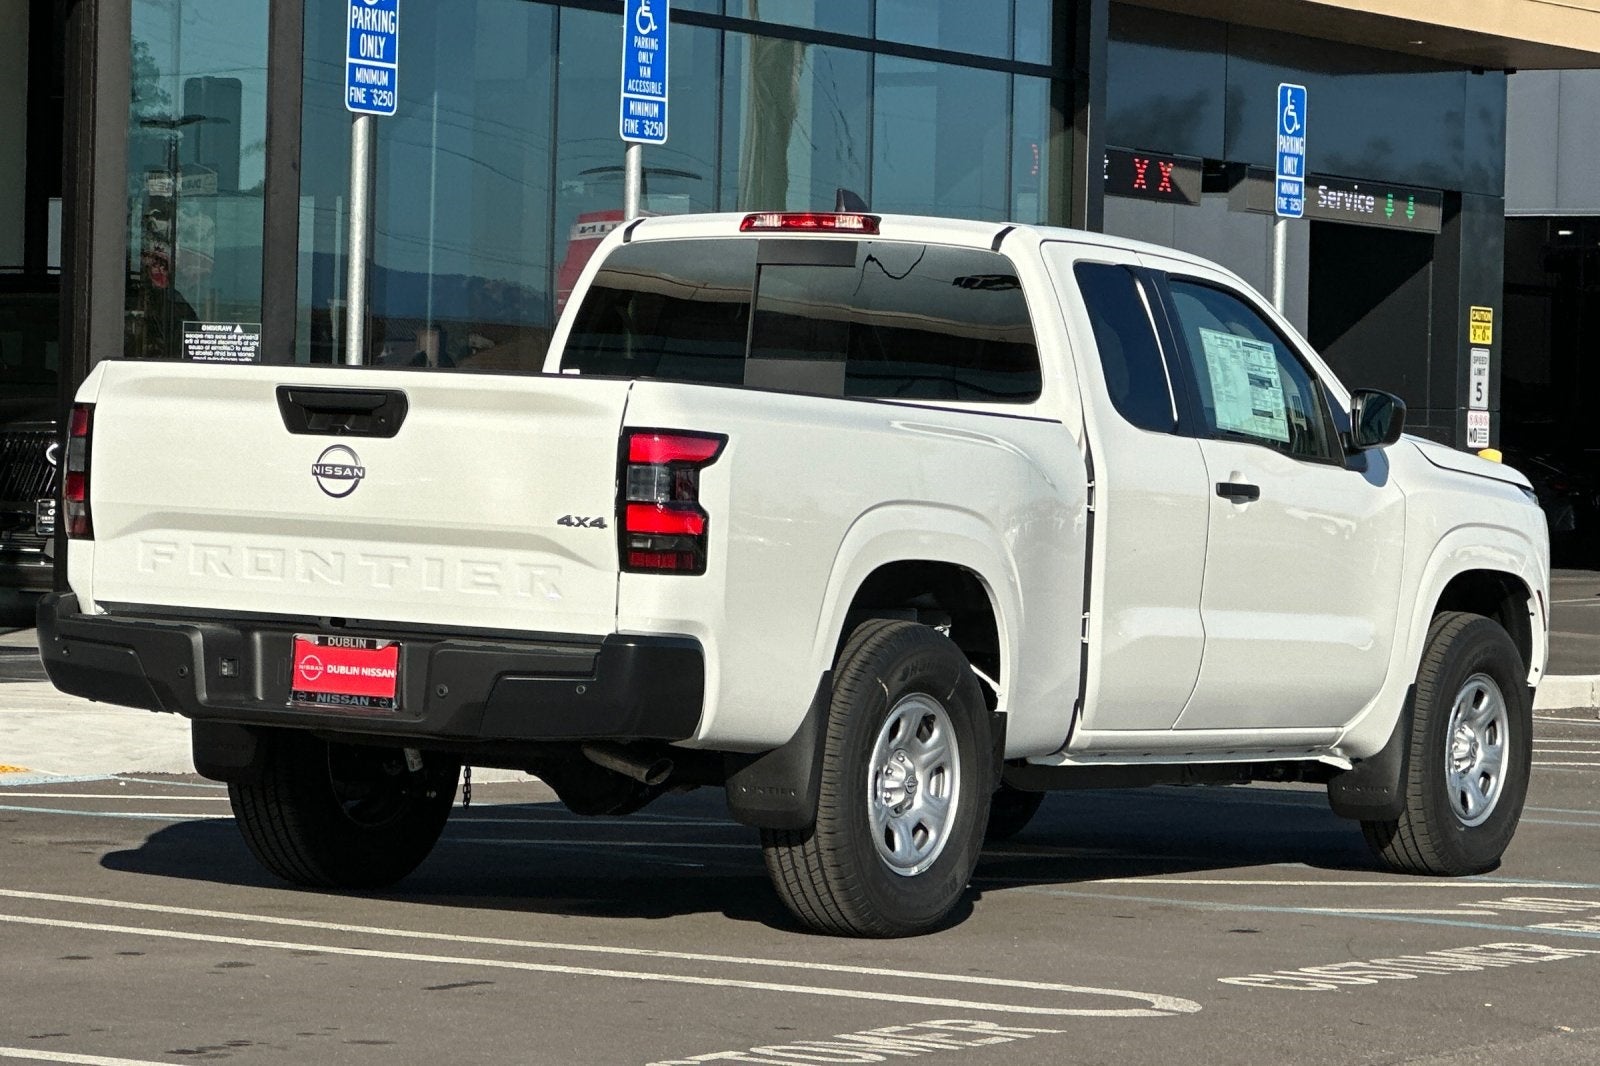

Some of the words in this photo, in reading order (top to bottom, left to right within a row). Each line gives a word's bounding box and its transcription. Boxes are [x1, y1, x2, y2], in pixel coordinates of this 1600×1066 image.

[351, 5, 396, 35] PARKING
[359, 33, 386, 59] ONLY
[633, 35, 659, 51] PARKING
[637, 50, 654, 65] ONLY
[355, 67, 389, 87] MINIMUM
[639, 65, 652, 79] VAN
[627, 78, 663, 95] ACCESSIBLE
[349, 86, 367, 104] FINE
[370, 88, 393, 107] $250
[629, 100, 659, 118] MINIMUM
[624, 118, 640, 135] FINE
[642, 119, 664, 137] $250
[1279, 134, 1304, 156] PARKING
[1283, 155, 1299, 175] ONLY
[1318, 184, 1375, 213] Service
[1473, 355, 1488, 366] SPEED
[1473, 367, 1486, 377] LIMIT
[1475, 382, 1483, 402] 5
[1468, 427, 1478, 443] NO
[312, 465, 363, 477] NISSAN
[138, 540, 562, 599] FRONTIER
[327, 637, 367, 649] DUBLIN
[299, 663, 324, 671] NISSAN
[327, 664, 360, 676] DUBLIN
[361, 667, 395, 678] NISSAN
[316, 693, 370, 706] NISSAN
[1217, 942, 1600, 991] CUSTOMER
